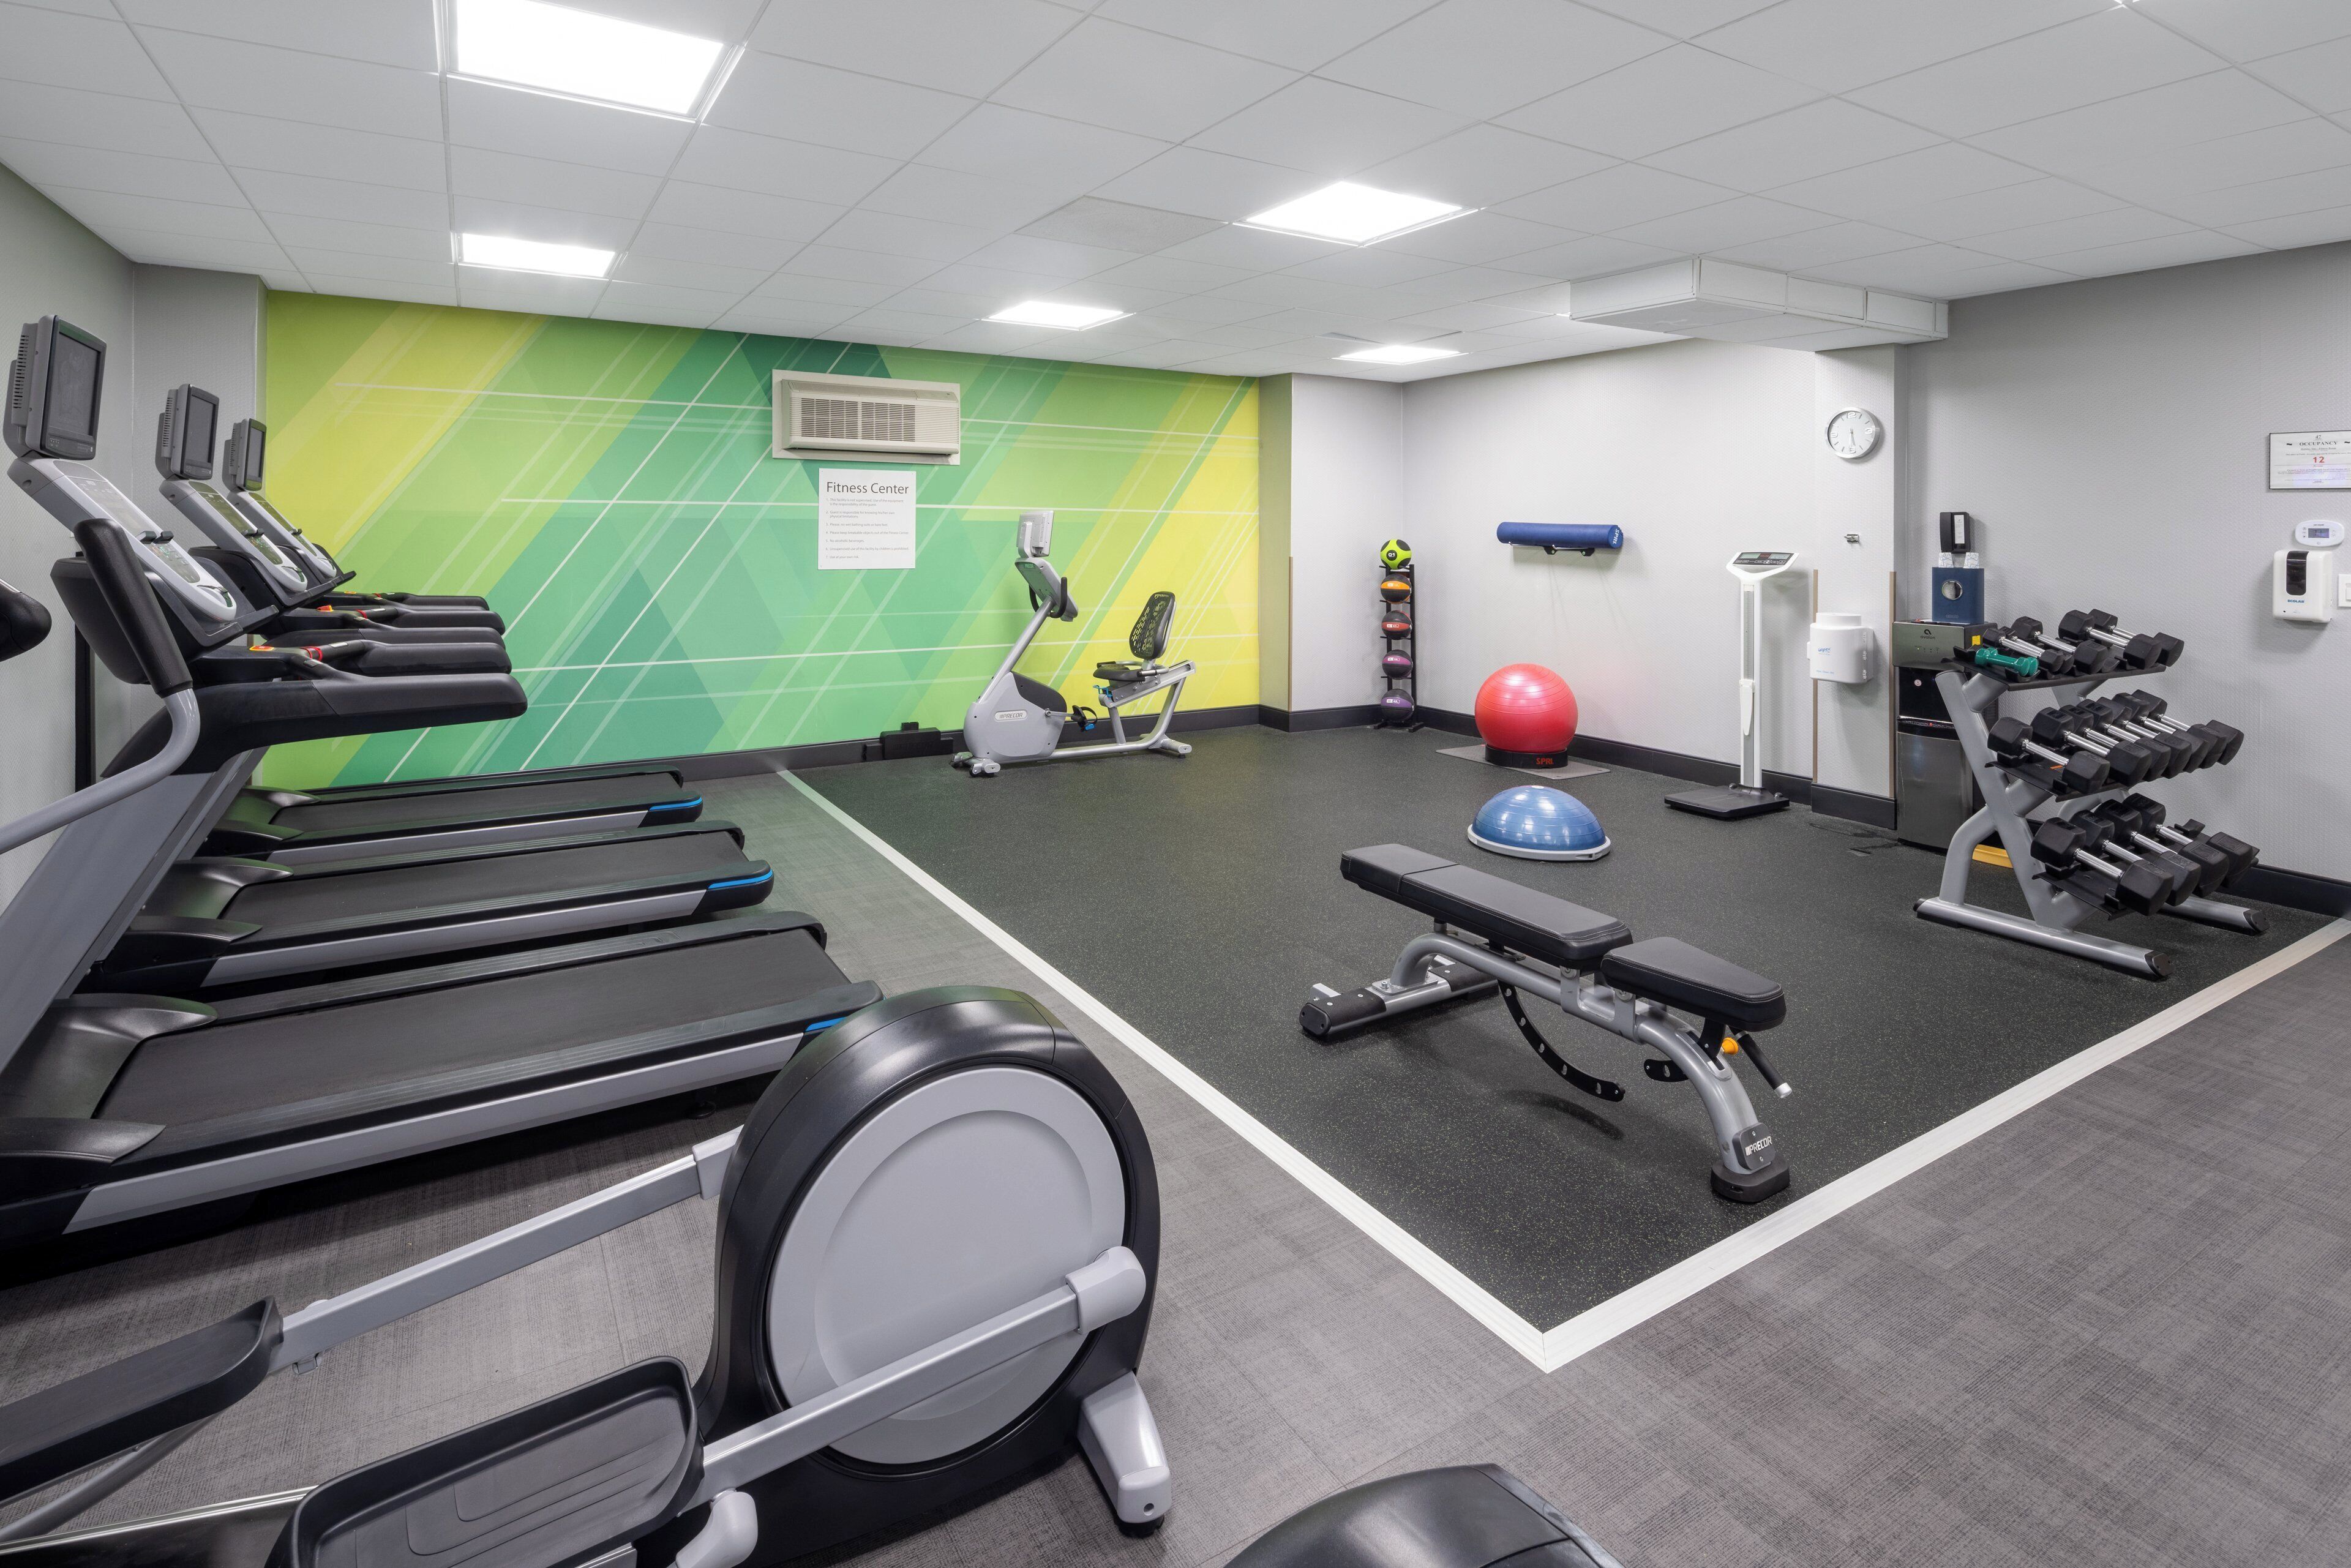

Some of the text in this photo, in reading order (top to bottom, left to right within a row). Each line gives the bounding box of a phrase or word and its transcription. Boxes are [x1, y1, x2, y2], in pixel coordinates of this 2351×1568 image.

[827, 482, 909, 494] Fitness Center
[1749, 1136, 1772, 1155] PRECOR
